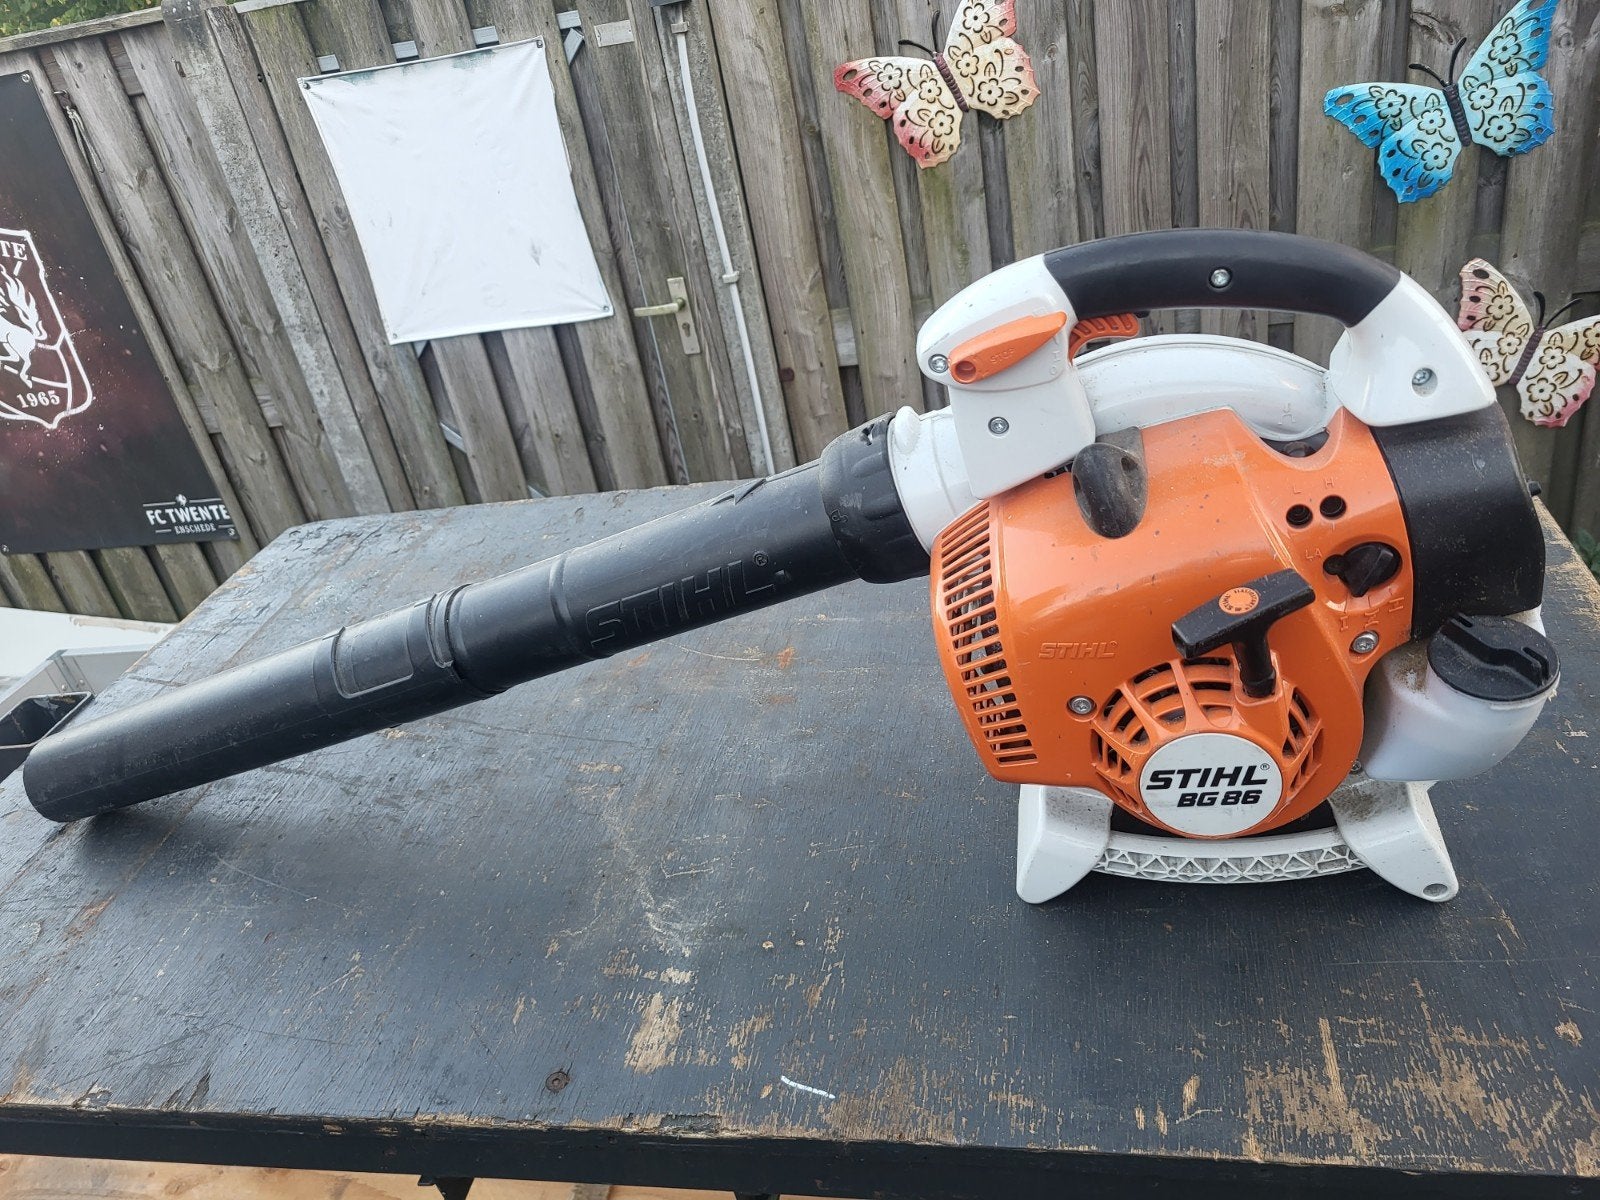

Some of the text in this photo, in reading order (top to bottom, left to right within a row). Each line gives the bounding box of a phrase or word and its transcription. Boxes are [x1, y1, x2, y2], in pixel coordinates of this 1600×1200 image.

[17, 389, 61, 409] 1965
[145, 504, 231, 526] FC TWENTE
[174, 522, 217, 535] ENSCHEDE
[1177, 789, 1263, 808] BG 86
